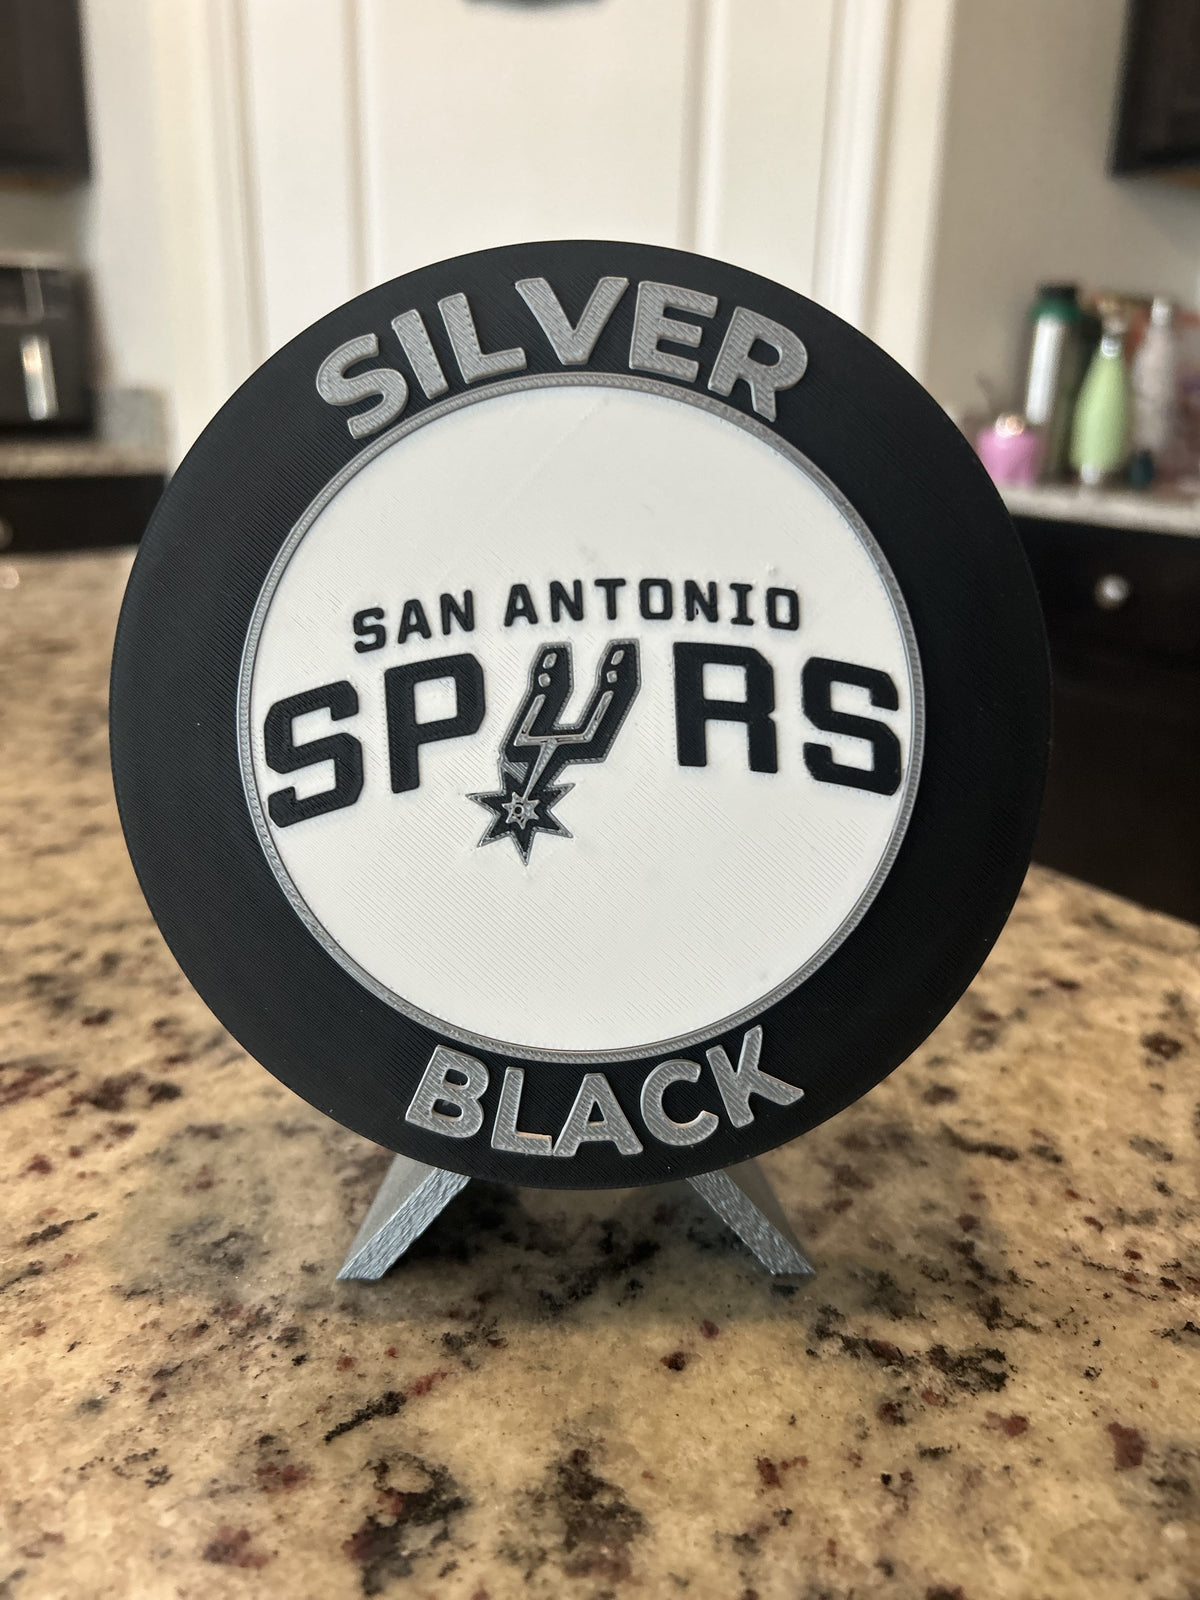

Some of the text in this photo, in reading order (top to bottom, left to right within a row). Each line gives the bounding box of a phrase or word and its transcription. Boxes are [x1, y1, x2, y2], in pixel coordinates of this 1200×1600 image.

[316, 276, 809, 438] SILVER
[353, 577, 801, 653] SAN ANTONIO
[263, 638, 902, 866] SPURS
[404, 1025, 805, 1159] BLACK
